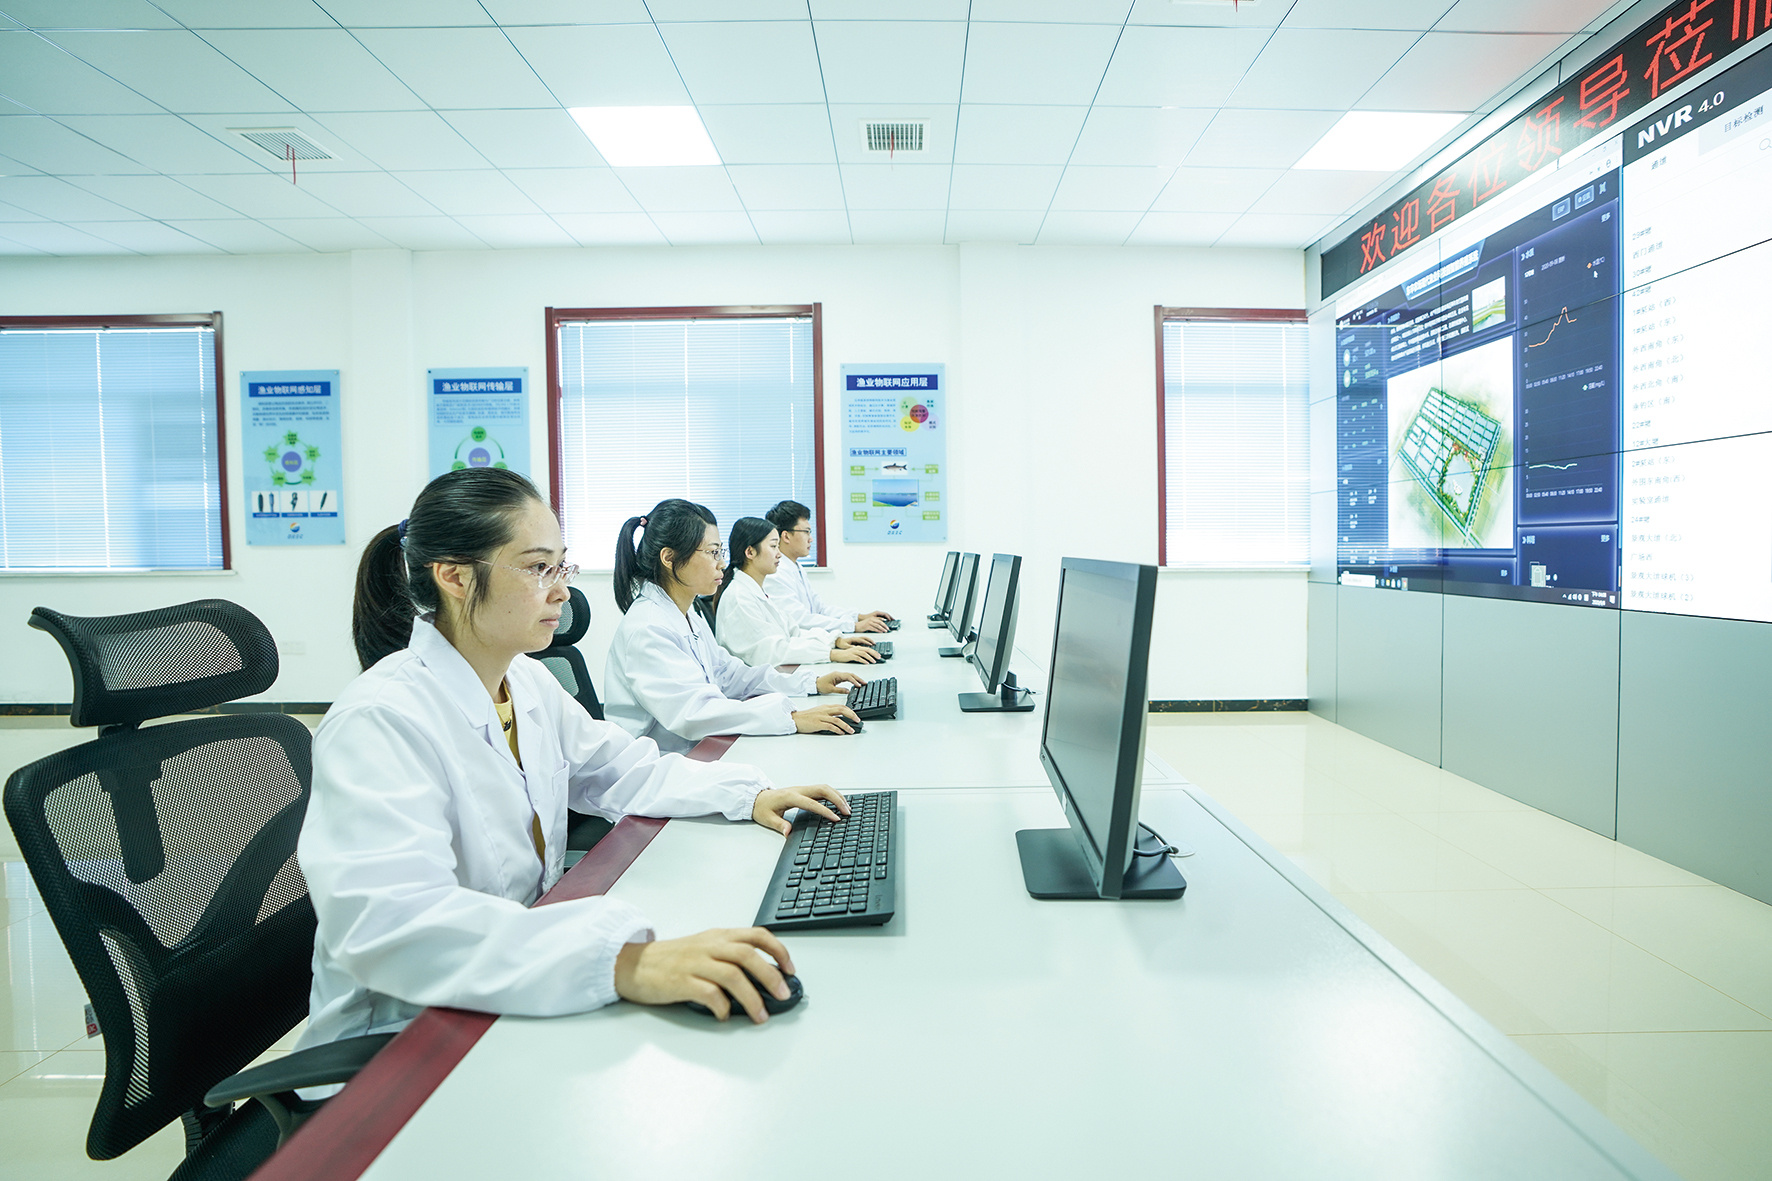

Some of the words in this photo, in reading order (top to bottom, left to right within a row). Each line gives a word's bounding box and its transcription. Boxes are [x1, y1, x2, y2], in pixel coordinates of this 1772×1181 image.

[1637, 104, 1693, 149] NVR
[1697, 91, 1725, 113] 4.0
[1724, 105, 1764, 133] 目标检测
[442, 381, 514, 392] 渔业物联网传输层
[856, 377, 928, 387] 渔业物联网应用层
[257, 385, 322, 395] 渔业物联网感知层
